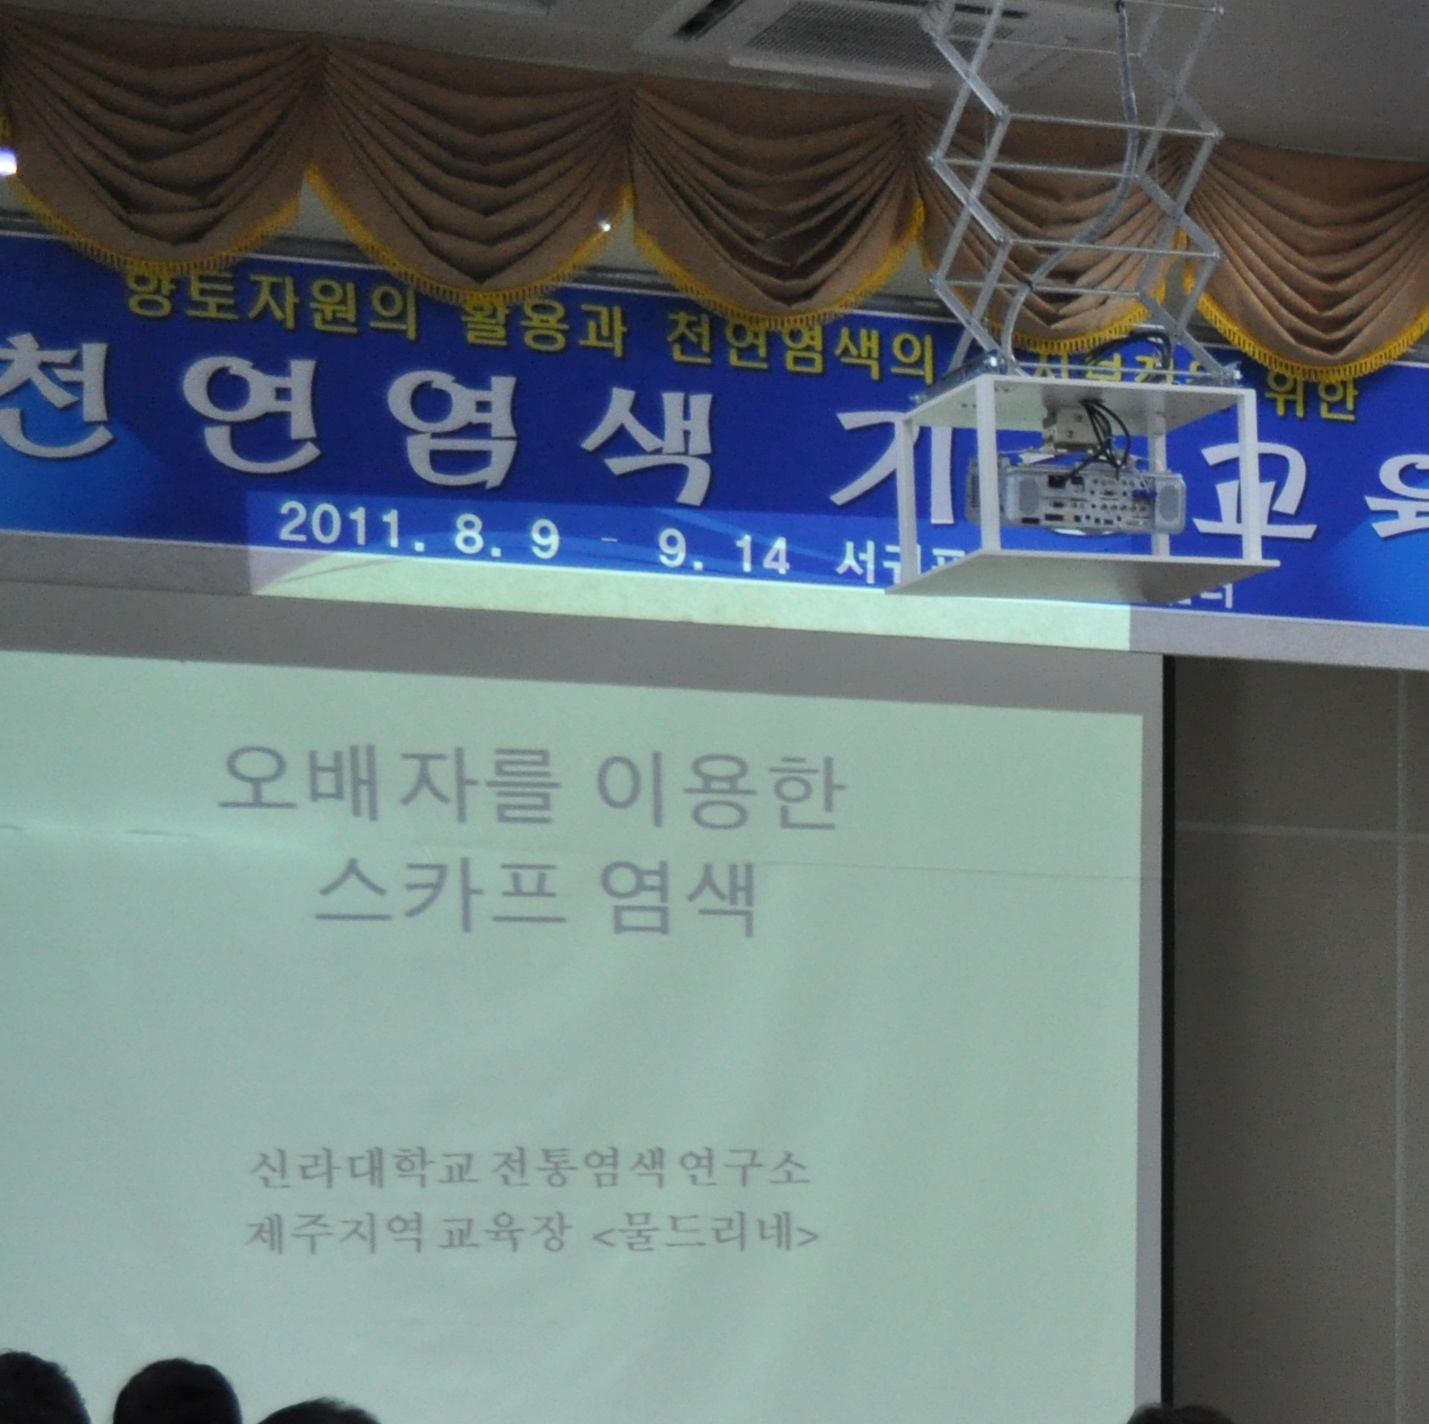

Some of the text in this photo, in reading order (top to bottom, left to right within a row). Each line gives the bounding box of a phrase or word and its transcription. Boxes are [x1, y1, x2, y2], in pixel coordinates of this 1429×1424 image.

[124, 268, 1359, 422] 향토자원의 활용과 천연염색의 위한
[0, 332, 715, 505] 천연염색
[735, 534, 791, 575] 14
[217, 744, 847, 830] 오배자를 이용한
[315, 857, 756, 937] 스카프 염색
[250, 1145, 480, 1190] 신라대학교
[246, 1211, 423, 1254] 제주지역
[438, 1211, 573, 1253] 교육장
